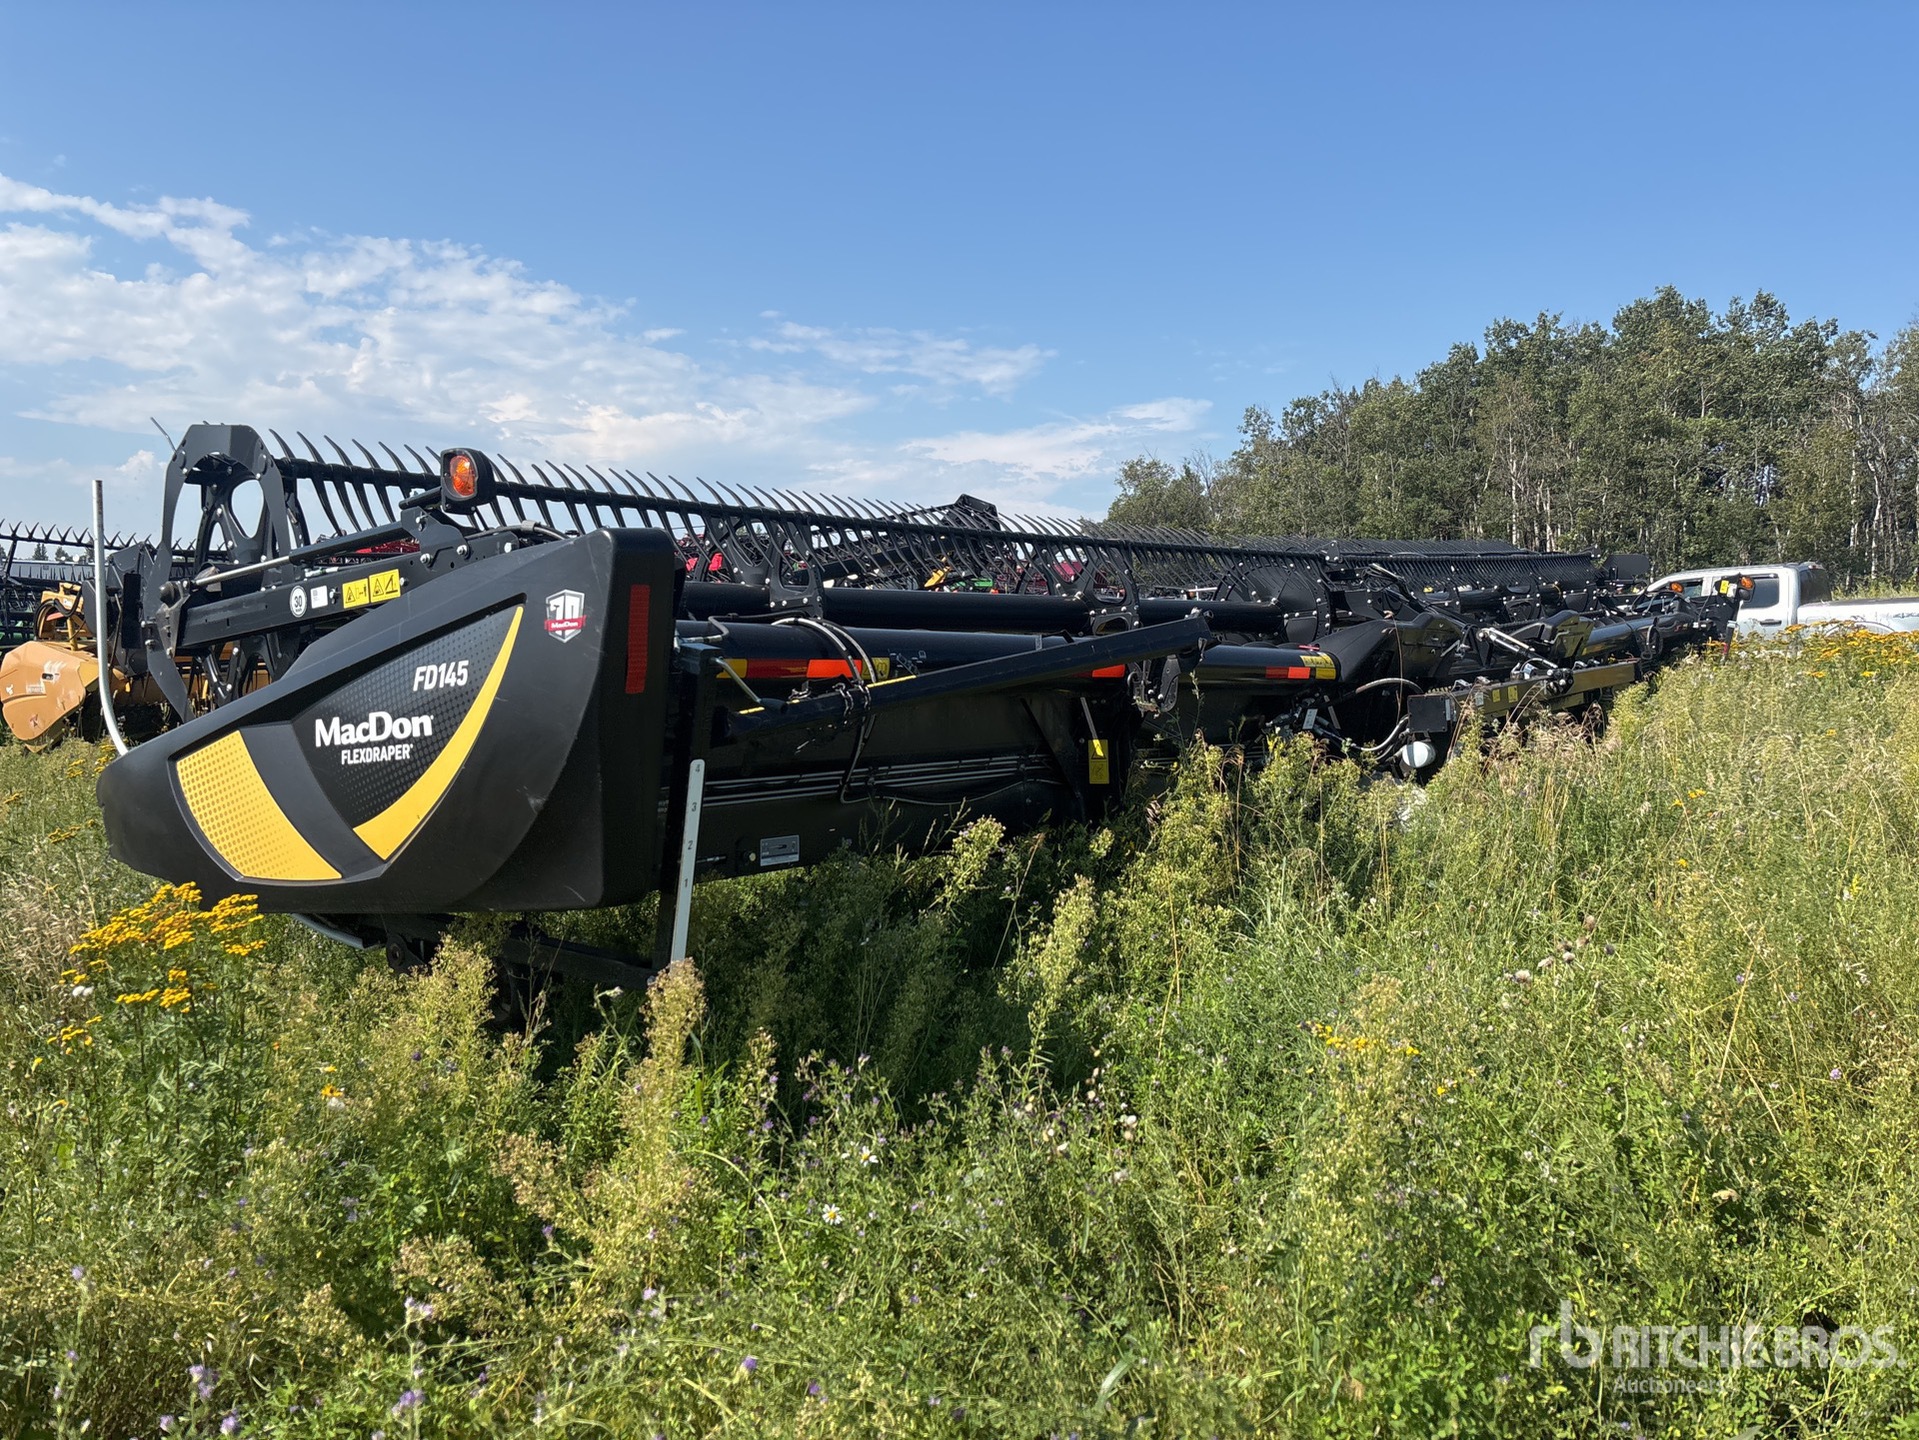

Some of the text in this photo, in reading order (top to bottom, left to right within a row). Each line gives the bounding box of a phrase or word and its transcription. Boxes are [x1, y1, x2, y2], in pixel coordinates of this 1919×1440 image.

[294, 596, 304, 608] 30
[413, 660, 469, 691] FD145
[315, 711, 433, 747] MacDon
[341, 744, 411, 766] FLEXDRAPER
